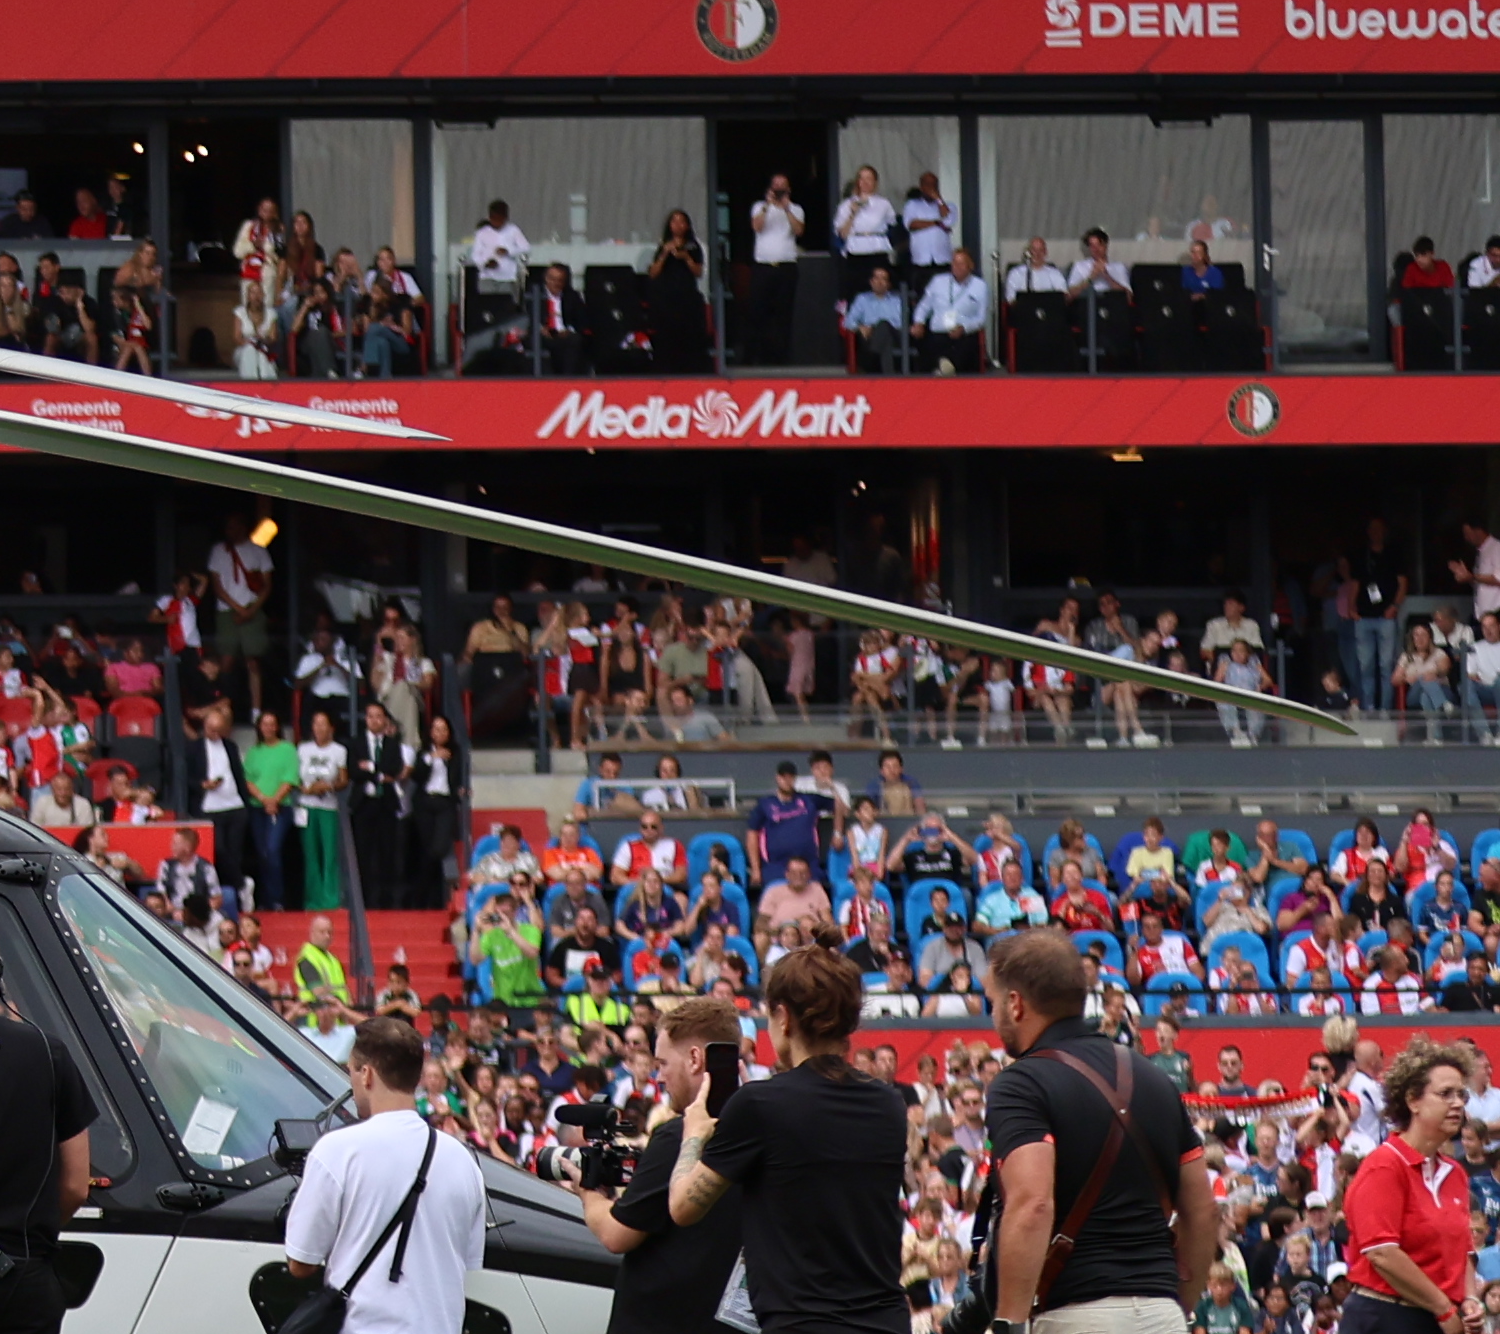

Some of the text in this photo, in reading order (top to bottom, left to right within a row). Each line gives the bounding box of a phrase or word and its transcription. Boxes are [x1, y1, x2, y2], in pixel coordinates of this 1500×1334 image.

[1089, 2, 1240, 38] DEME
[31, 398, 122, 417] Gemeente
[536, 388, 871, 439] Media Markt
